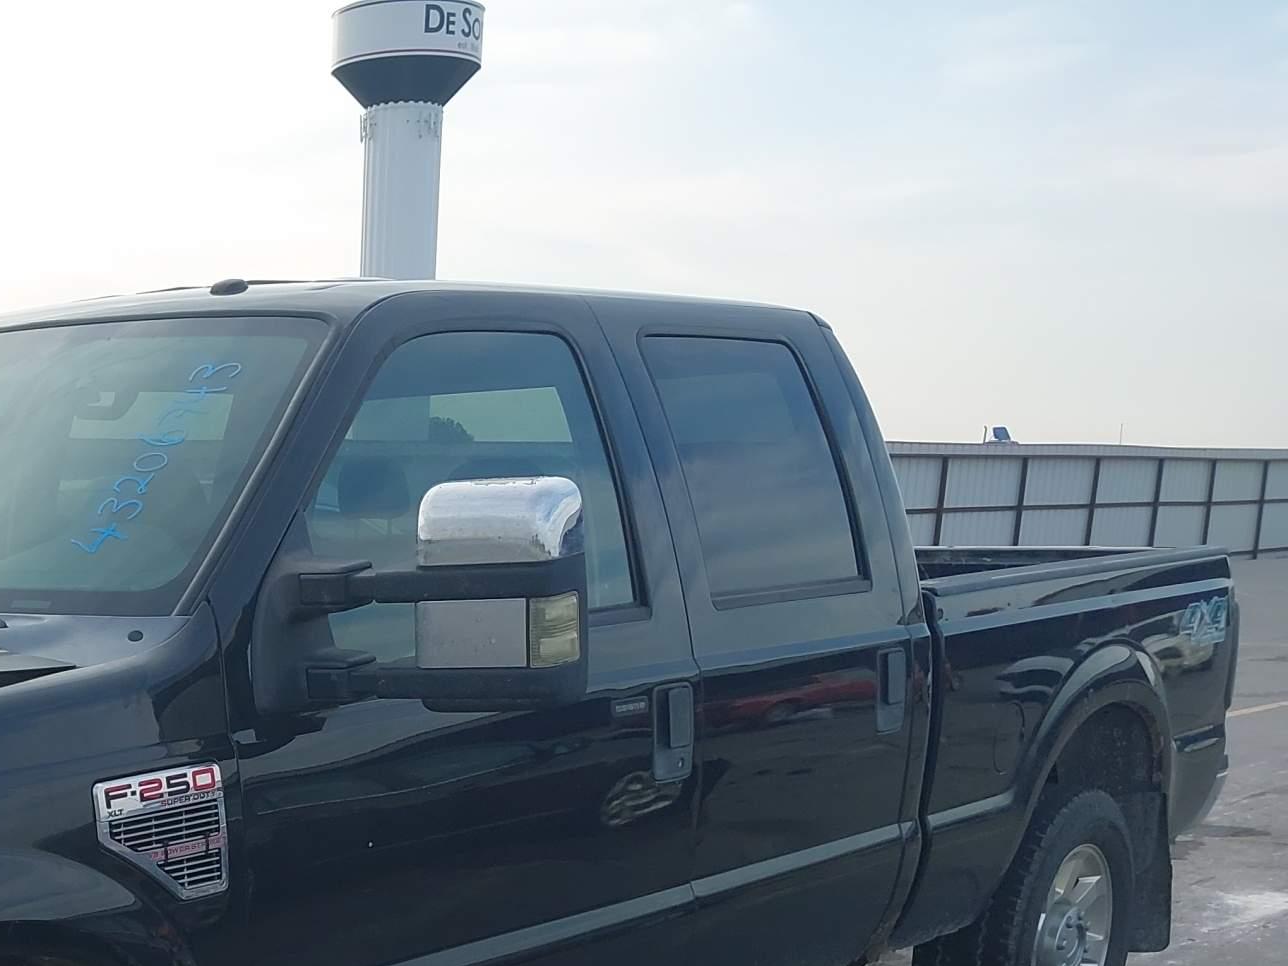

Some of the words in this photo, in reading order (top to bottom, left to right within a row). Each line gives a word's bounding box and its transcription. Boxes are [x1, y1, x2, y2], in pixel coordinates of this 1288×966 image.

[70, 361, 243, 555] 43206743
[103, 767, 216, 810] F-250
[107, 808, 124, 818] XLT
